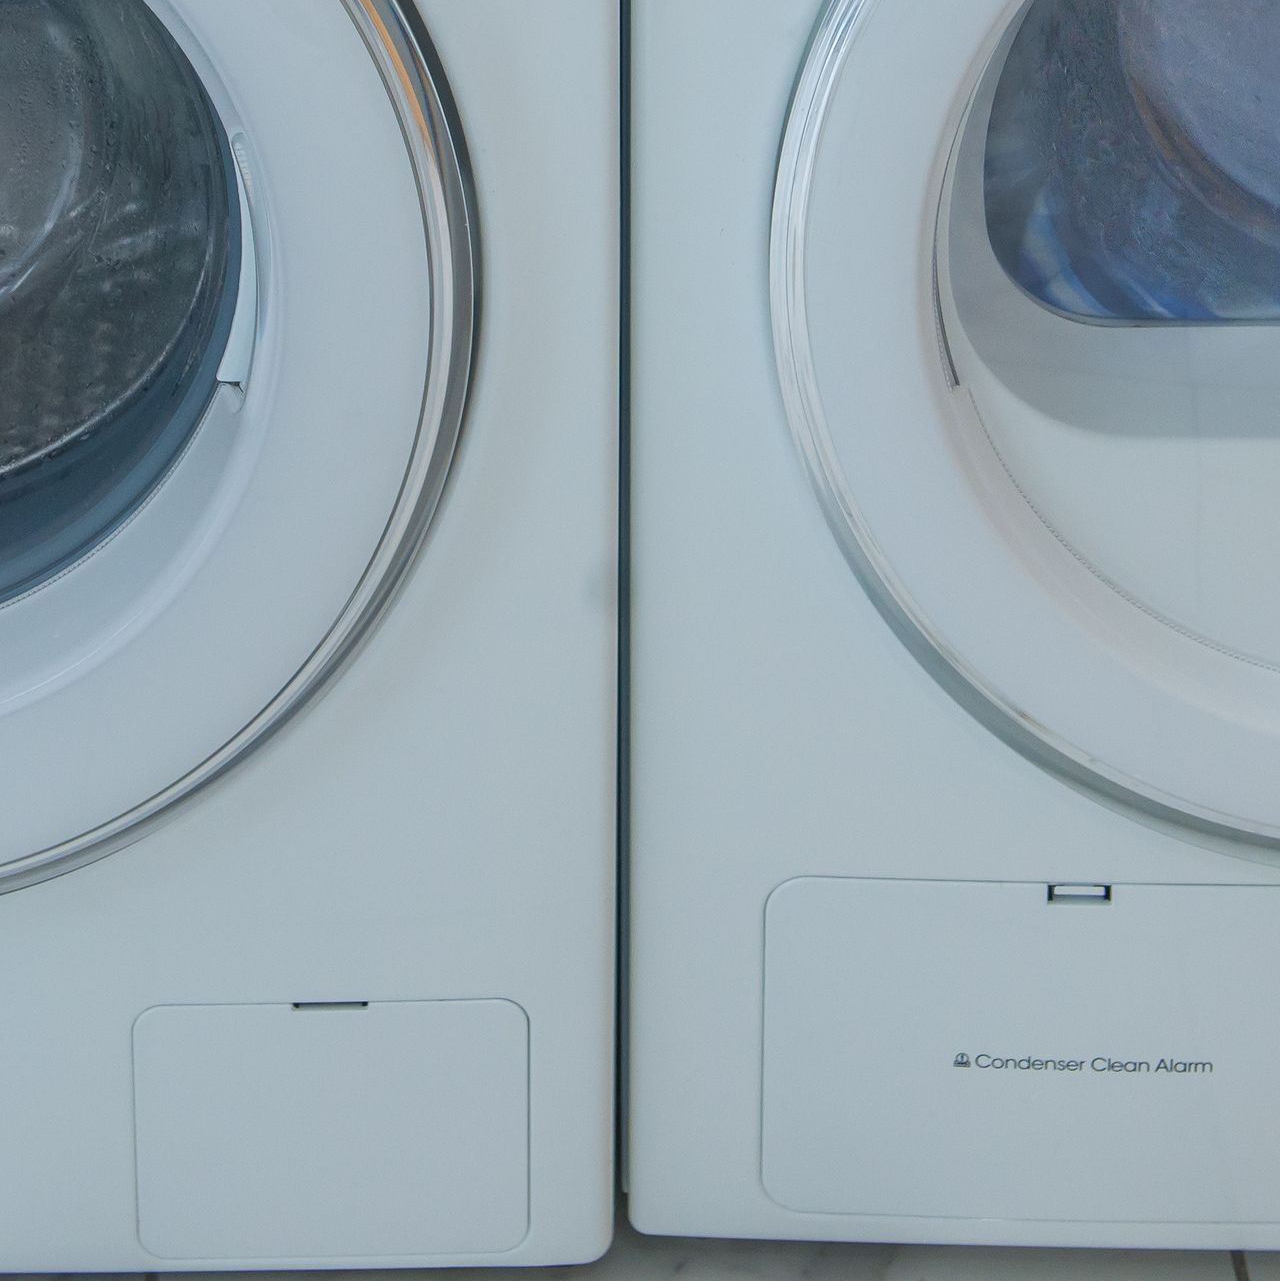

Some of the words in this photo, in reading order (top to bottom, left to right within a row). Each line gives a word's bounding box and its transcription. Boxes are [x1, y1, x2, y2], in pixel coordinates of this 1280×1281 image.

[975, 1053, 1086, 1073] Condenser
[1091, 1056, 1151, 1074] Clean
[1155, 1057, 1213, 1074] Alarm
